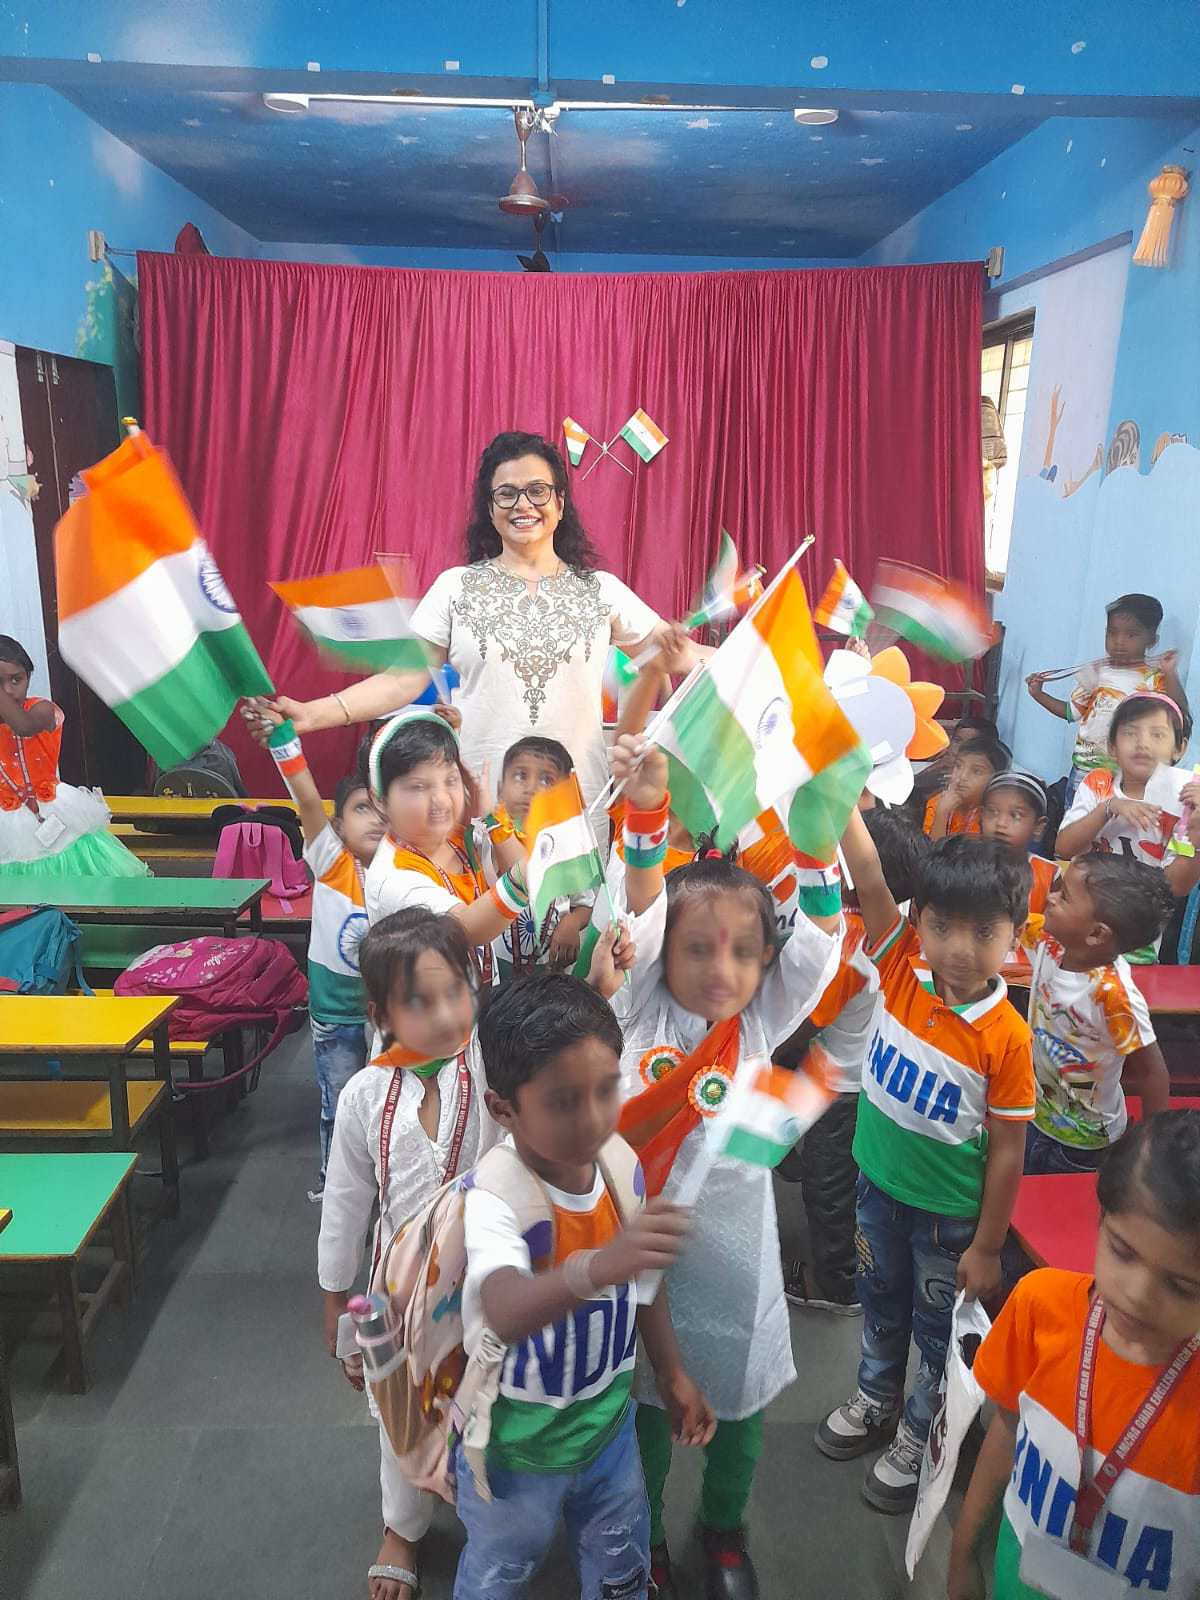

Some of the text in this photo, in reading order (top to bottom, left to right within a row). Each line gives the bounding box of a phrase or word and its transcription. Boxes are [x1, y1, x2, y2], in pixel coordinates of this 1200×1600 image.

[1118, 836, 1137, 859] I
[382, 1111, 392, 1138] SCHOOL
[388, 1079, 400, 1104] JUNIOR
[868, 1027, 962, 1125] INDIA
[449, 1143, 459, 1170] SCHOOL
[455, 1110, 466, 1137] JUNIOR
[461, 1080, 469, 1109] COLLEGE
[499, 1281, 637, 1397] NDI
[1082, 1328, 1096, 1370] ENGLISH
[1088, 1304, 1103, 1329] HIGH
[1115, 1426, 1141, 1460] AMCHA
[1150, 1368, 1178, 1407] ENGLISH
[1172, 1347, 1193, 1371] HIGH
